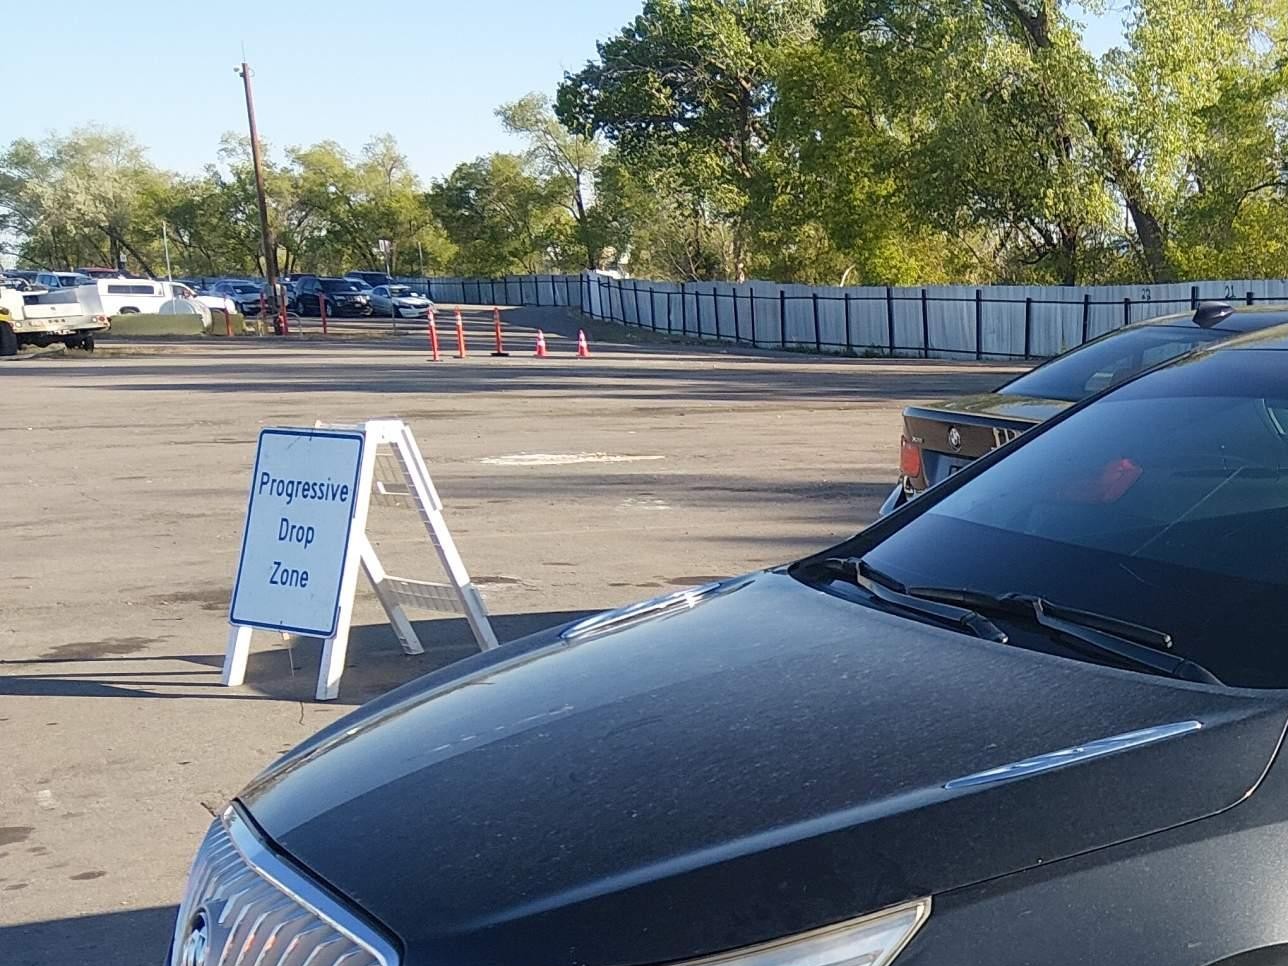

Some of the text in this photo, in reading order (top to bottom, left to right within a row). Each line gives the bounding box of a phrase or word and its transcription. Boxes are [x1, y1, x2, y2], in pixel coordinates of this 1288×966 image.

[1224, 284, 1237, 299] 21
[258, 471, 349, 505] Progressive
[278, 517, 315, 549] Drop
[269, 561, 309, 588] Zone
